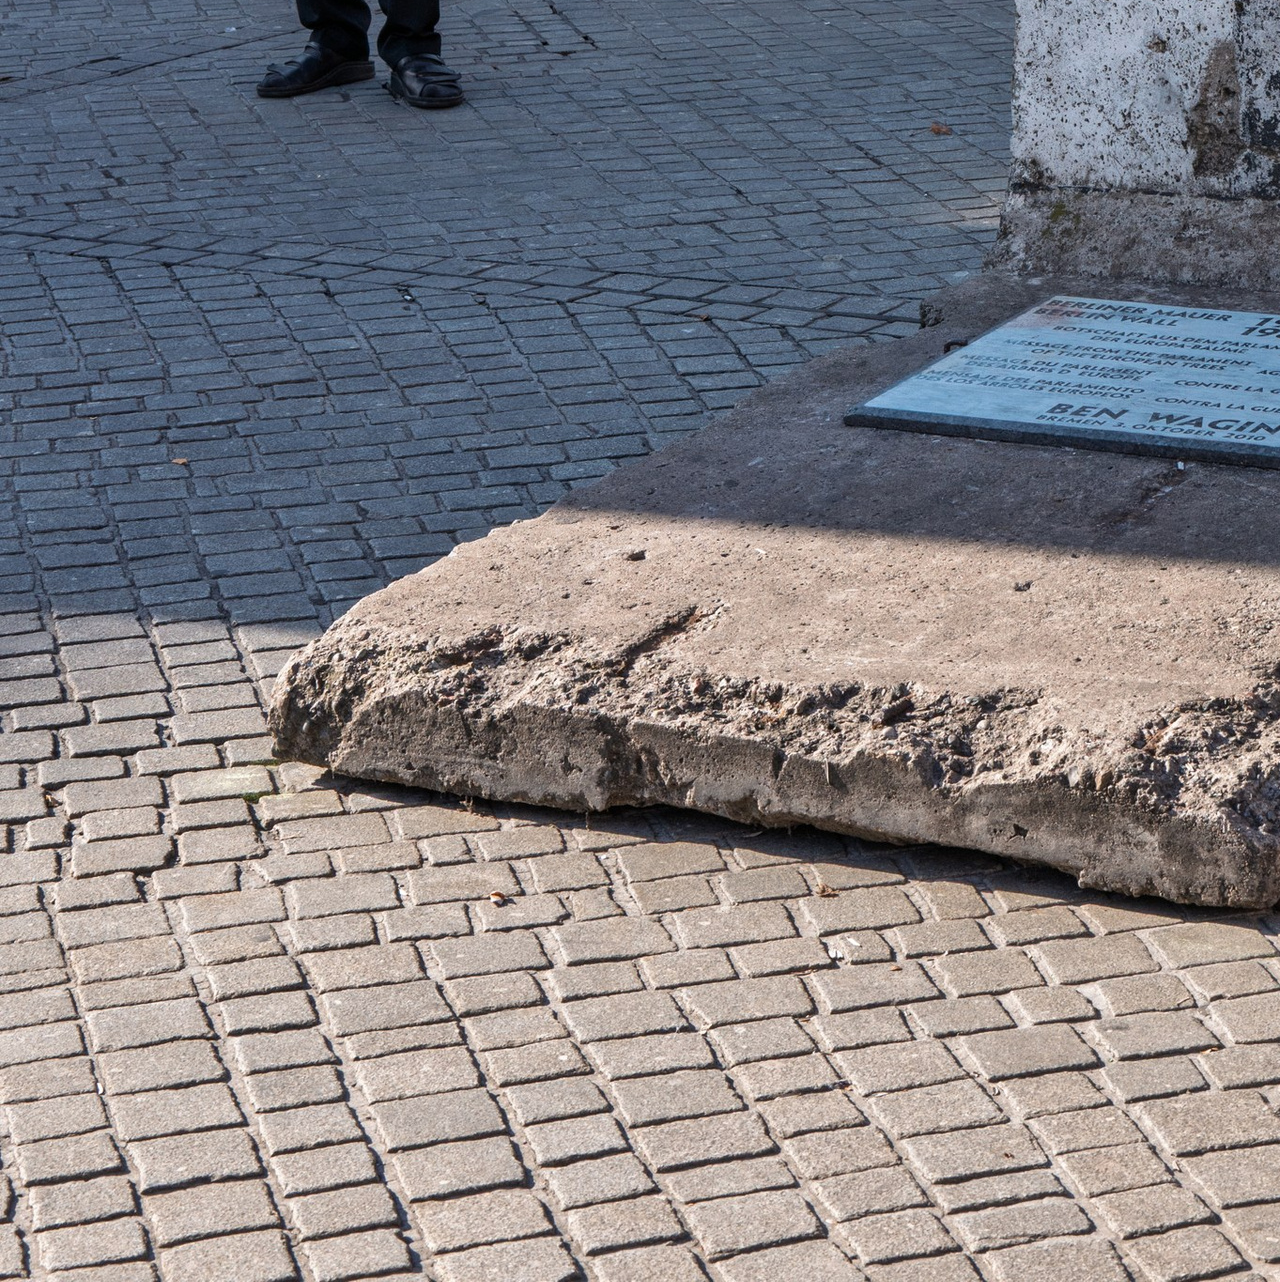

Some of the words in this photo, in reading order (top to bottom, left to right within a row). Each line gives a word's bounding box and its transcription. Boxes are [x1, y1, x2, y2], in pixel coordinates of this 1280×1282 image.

[1033, 307, 1116, 321] BERLIN
[1121, 315, 1179, 327] WALL
[1046, 300, 1148, 315] BERLINER
[1151, 309, 1233, 322] MAUER
[1053, 325, 1148, 339] BOTSCHAFT
[1148, 334, 1182, 342] AUS
[1182, 337, 1218, 345] DEM
[1090, 335, 1121, 343] DER
[1074, 345, 1121, 354] FROM
[1125, 349, 1158, 358] THE
[1032, 359, 1059, 367] DU
[1061, 362, 1156, 377] PARLEMENT
[1094, 355, 1177, 367] EUROPEAN
[1181, 362, 1227, 371] TREES
[1077, 370, 1145, 382] EUROPE
[1002, 376, 1030, 384] DEL
[1034, 378, 1145, 394] PARLAMENTO
[1047, 386, 1133, 399] EUROPEOS
[1174, 379, 1240, 391] CONTRE
[1046, 403, 1129, 421] BEN
[1154, 397, 1222, 408] CONTRA
[1225, 403, 1245, 411] LA
[1034, 413, 1107, 427] BREMEN
[1112, 421, 1127, 429] 3.
[1131, 423, 1217, 437] OKTOBER
[1224, 431, 1268, 442] 2010
